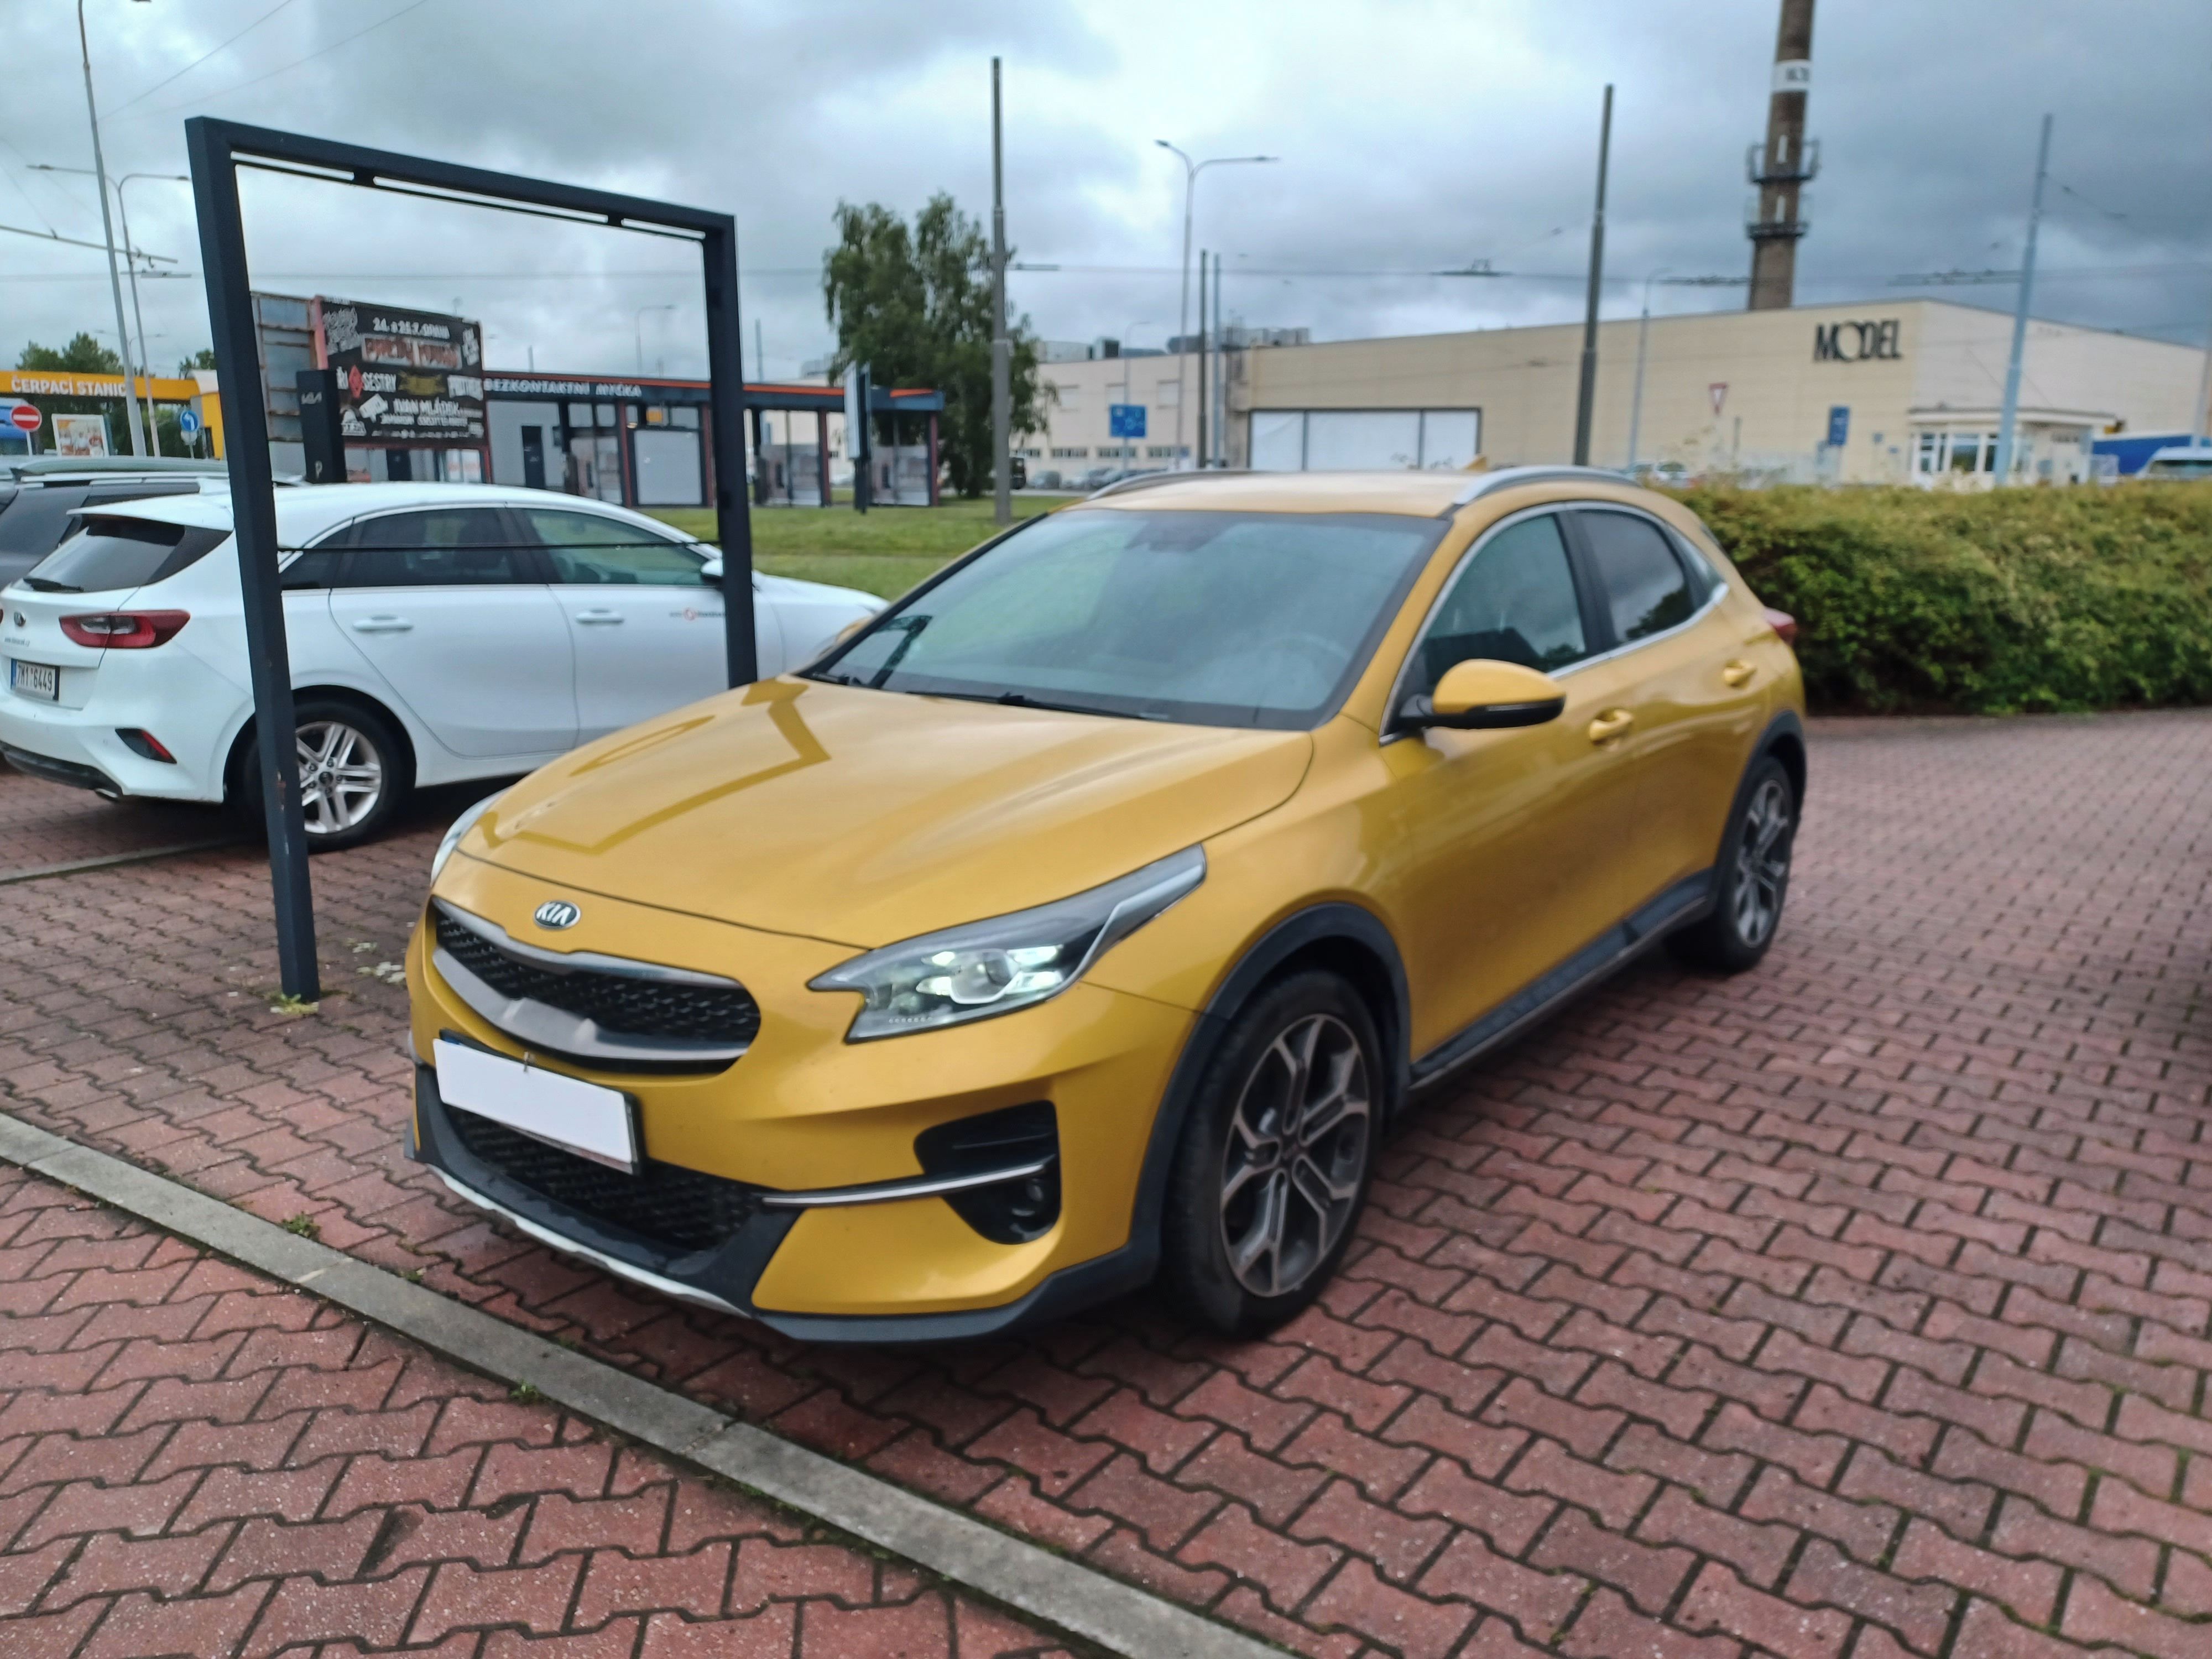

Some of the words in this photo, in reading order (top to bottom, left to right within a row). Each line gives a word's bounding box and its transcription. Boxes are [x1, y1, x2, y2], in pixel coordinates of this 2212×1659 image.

[1814, 318, 1901, 362] MODEL
[12, 375, 74, 395] ČERPACÍ
[77, 382, 127, 396] STANIC
[362, 372, 396, 392] SESTRY
[33, 667, 52, 691] 6449
[536, 902, 572, 926] KIA
